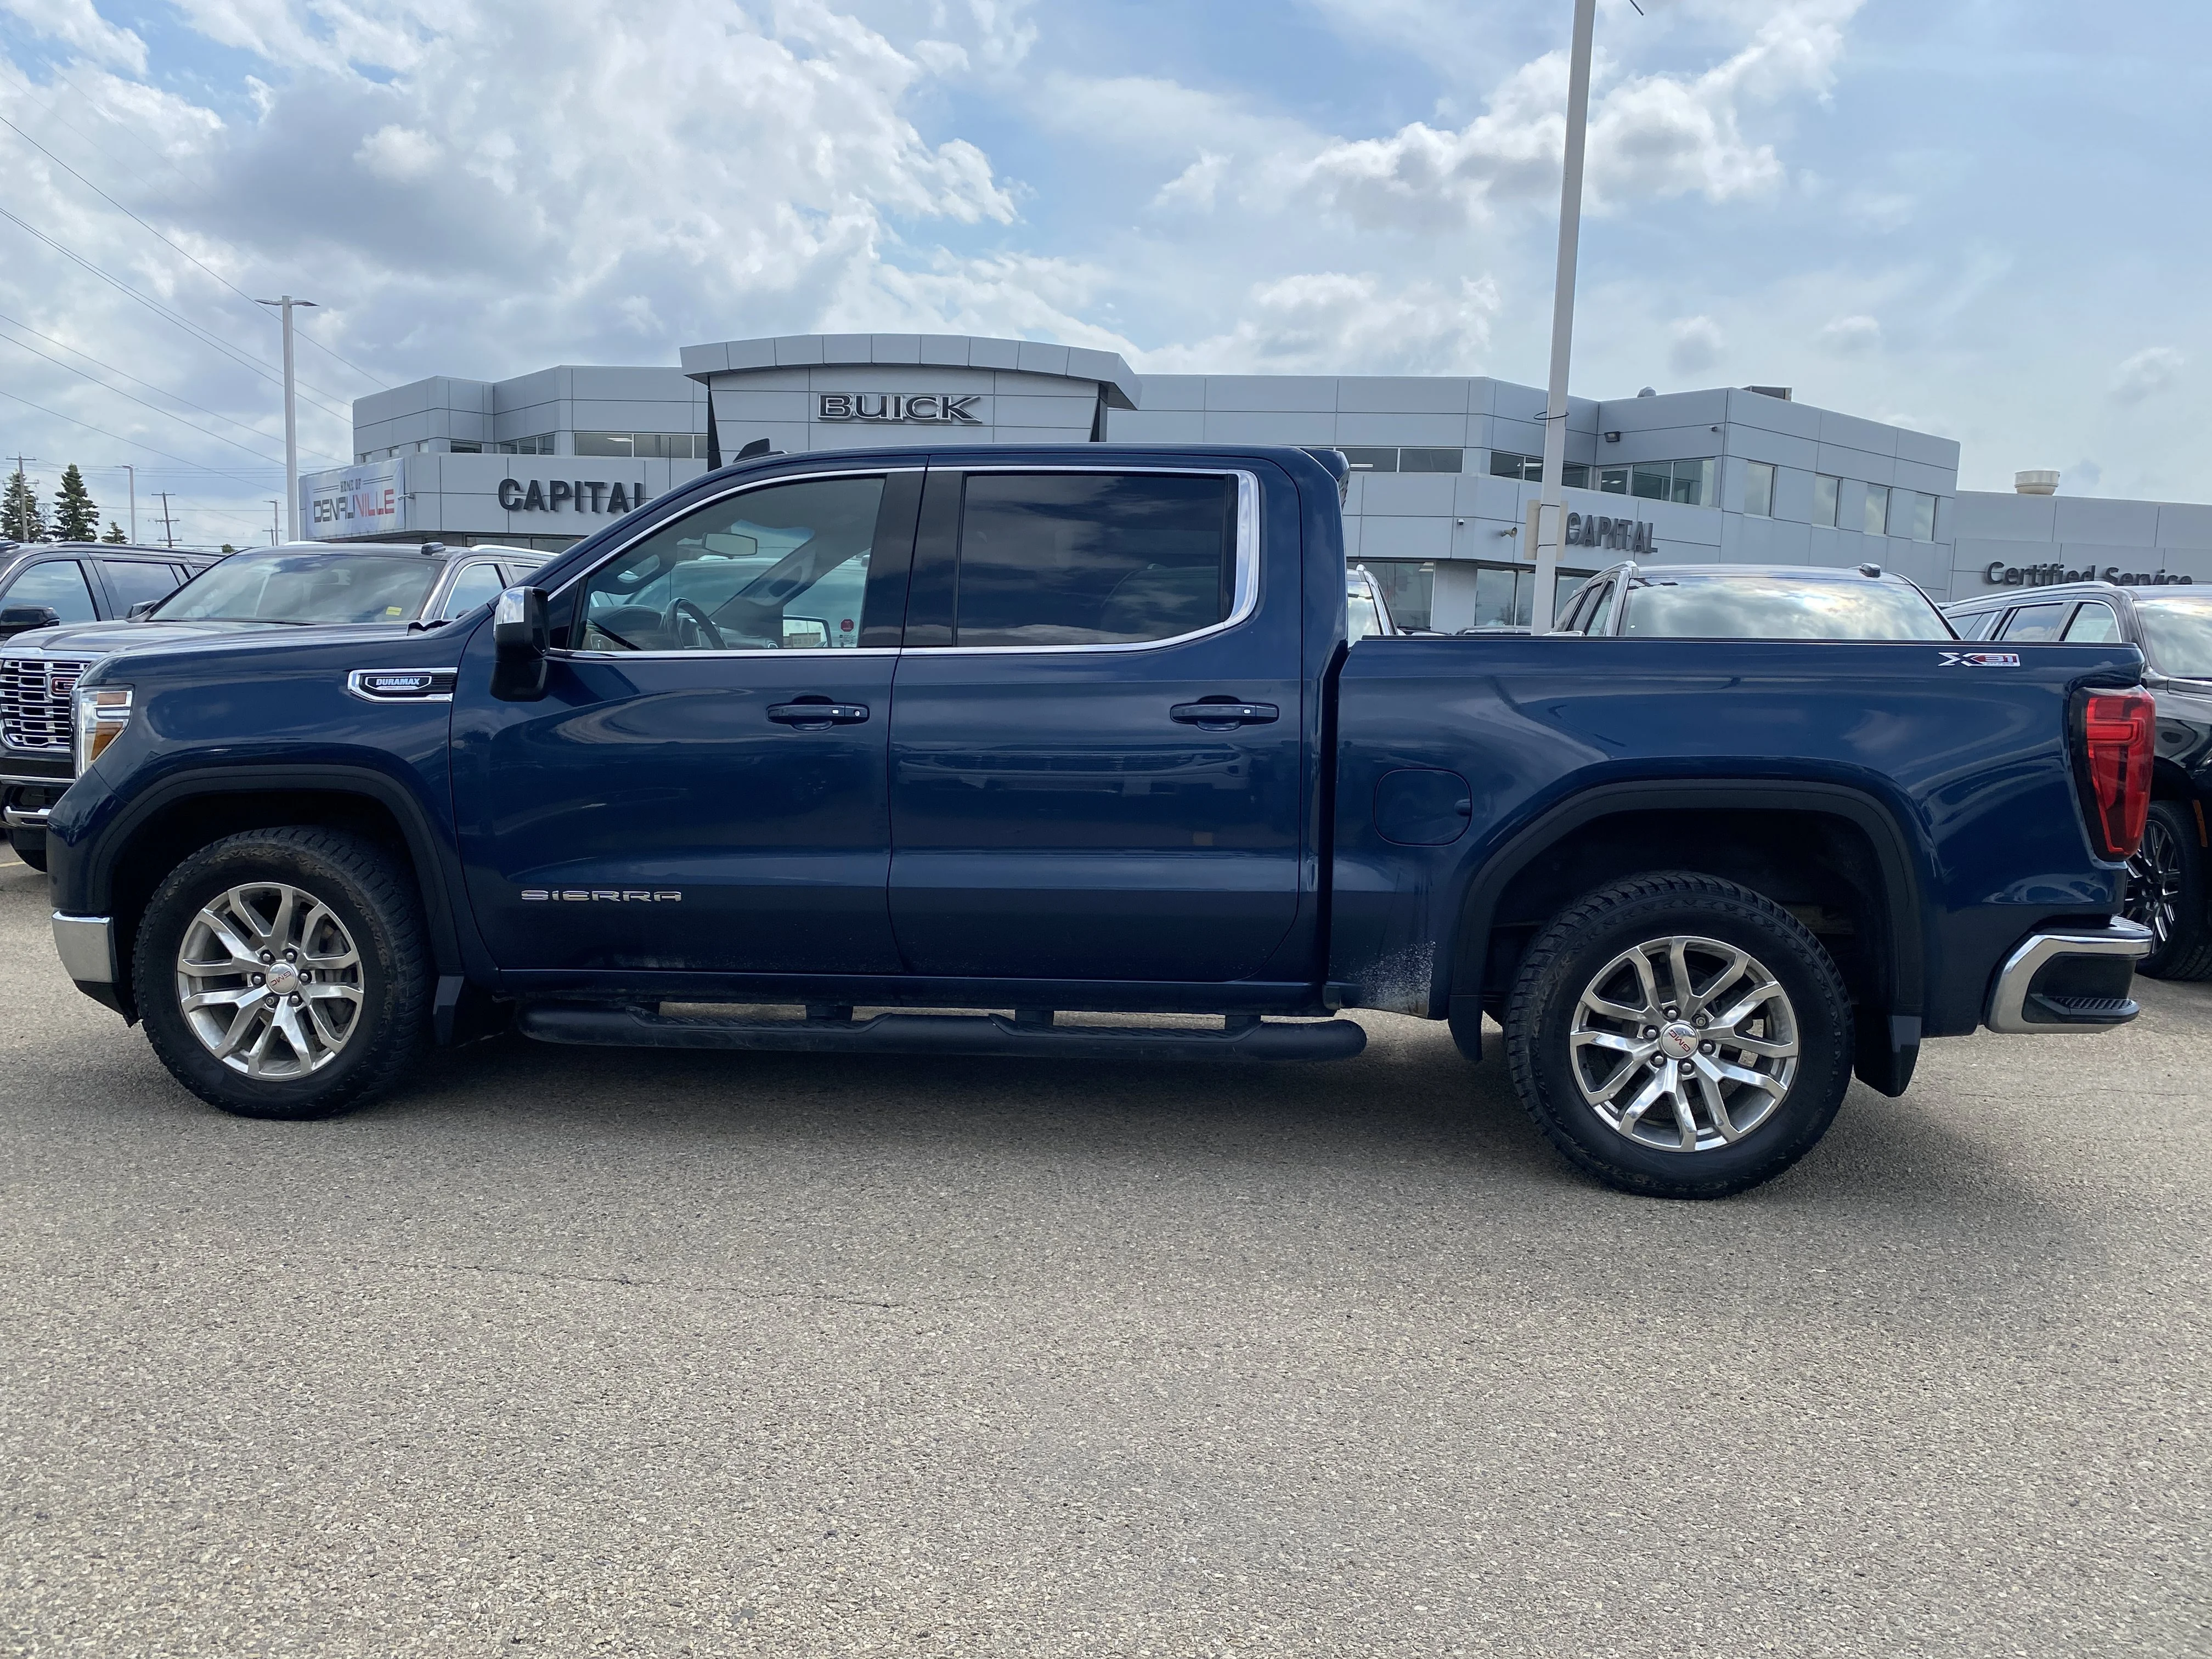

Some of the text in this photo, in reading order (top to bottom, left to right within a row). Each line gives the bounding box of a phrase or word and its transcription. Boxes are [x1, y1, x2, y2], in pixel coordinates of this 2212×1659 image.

[818, 393, 983, 424] BUICK
[340, 478, 362, 493] HOME OF
[1565, 512, 1658, 553] CAPITAL
[1987, 561, 2096, 586] Certified
[521, 890, 681, 902] SIERRA
[270, 970, 292, 986] GMC
[1668, 1029, 1690, 1052] GMC
